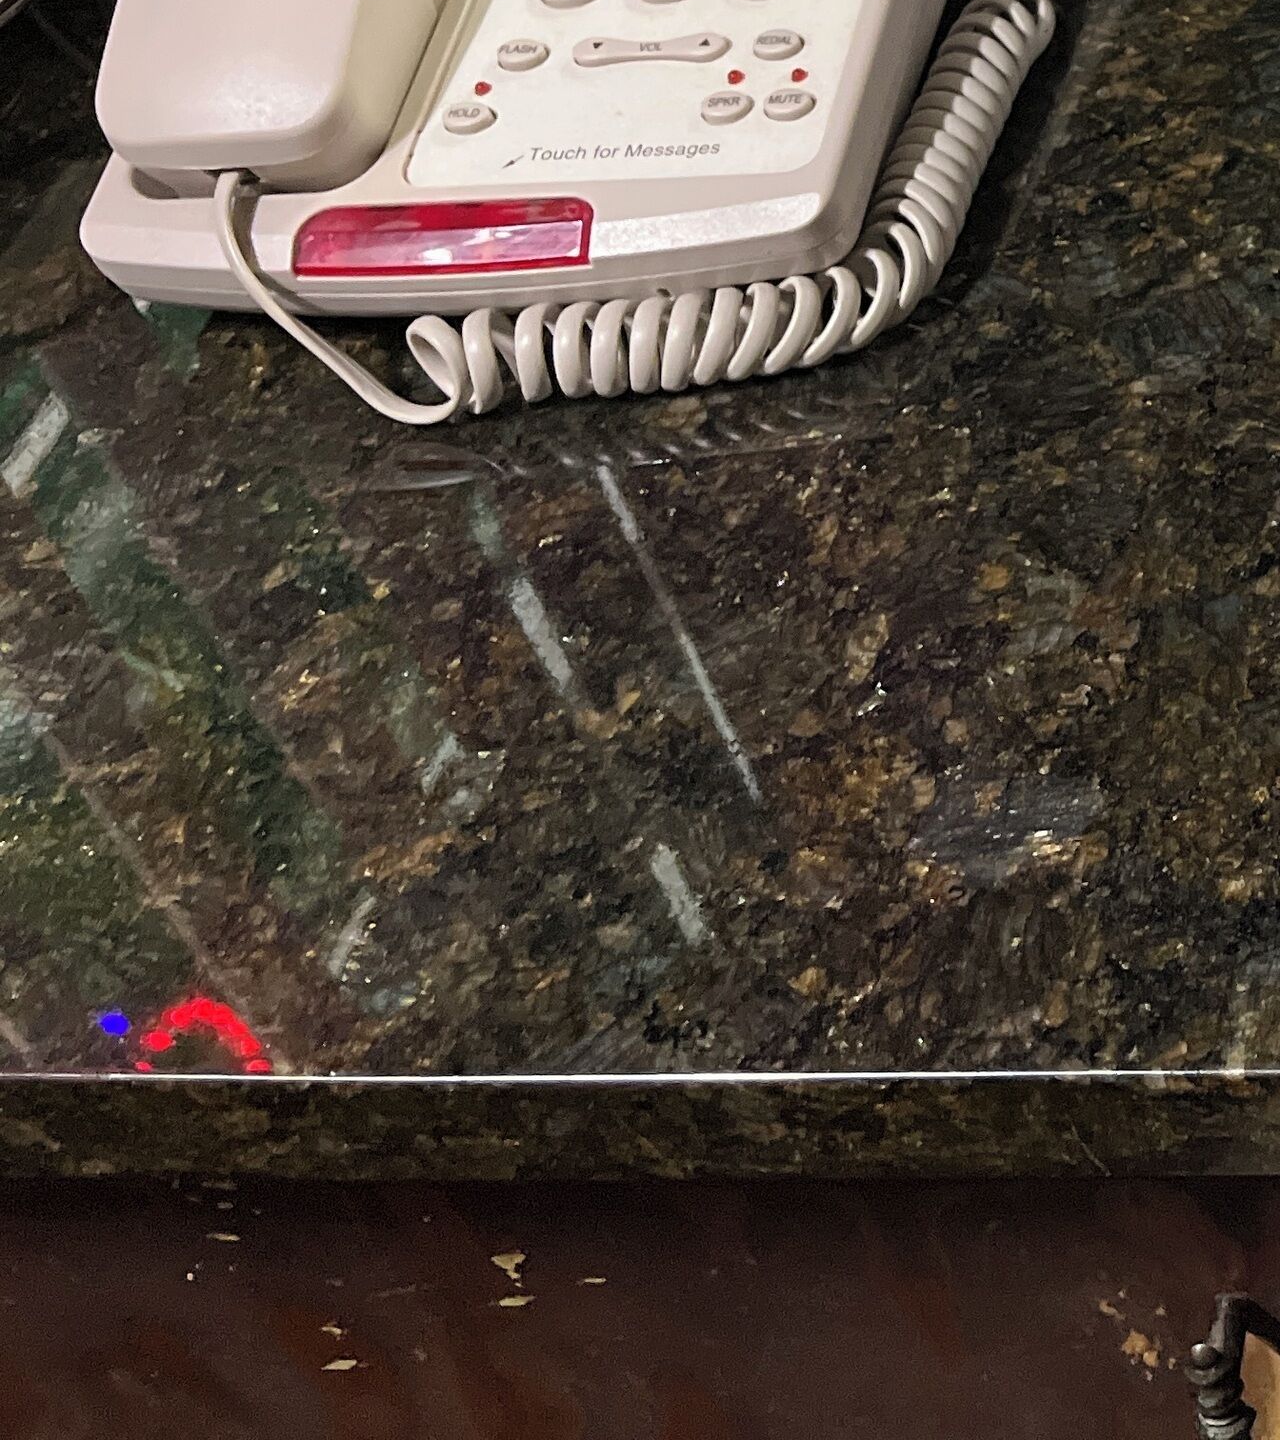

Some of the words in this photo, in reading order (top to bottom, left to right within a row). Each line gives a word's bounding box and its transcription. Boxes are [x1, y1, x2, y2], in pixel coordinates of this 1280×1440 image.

[756, 34, 793, 47] REDIAL
[498, 43, 538, 56] FLASH
[639, 42, 663, 53] VOL
[707, 95, 741, 108] SPKR
[768, 93, 803, 106] MUTE
[448, 107, 482, 119] HOLD
[529, 146, 587, 162] Touch
[593, 143, 620, 160] for
[624, 140, 721, 159] Messages
